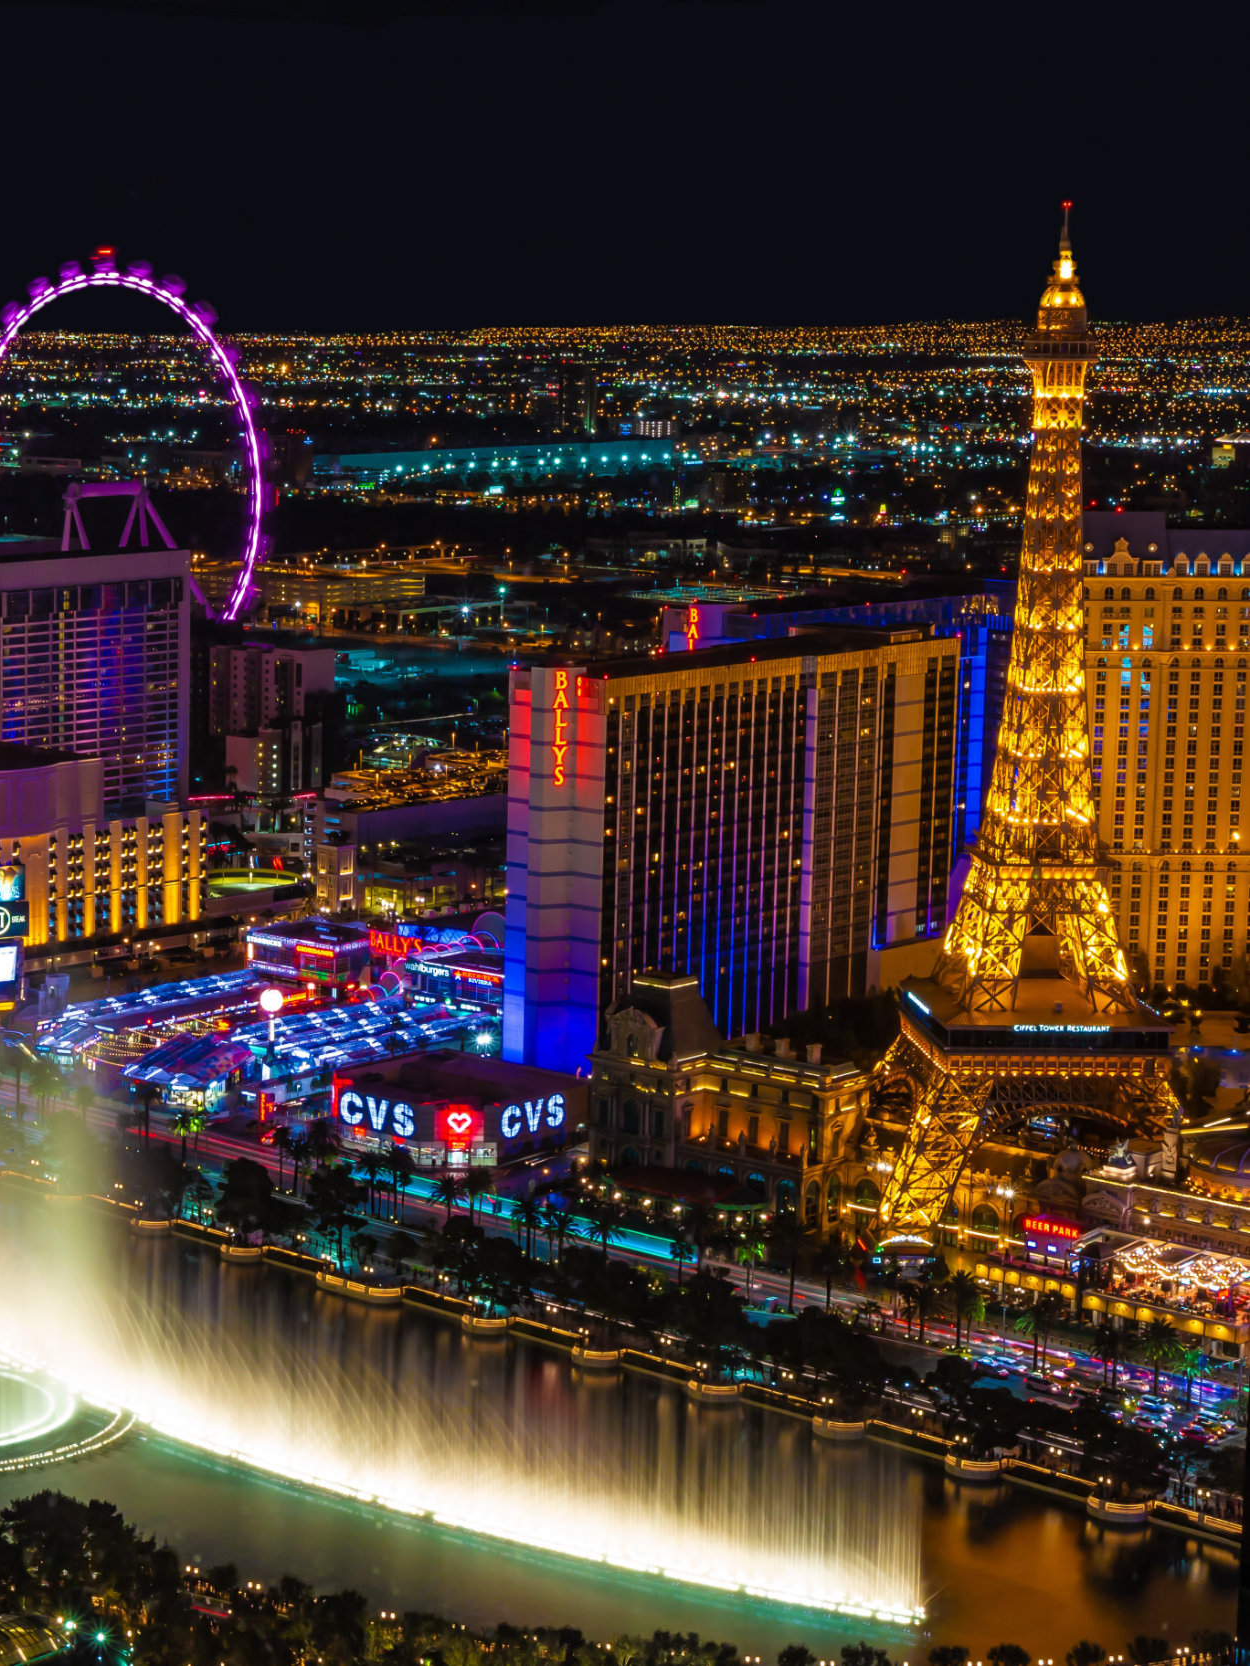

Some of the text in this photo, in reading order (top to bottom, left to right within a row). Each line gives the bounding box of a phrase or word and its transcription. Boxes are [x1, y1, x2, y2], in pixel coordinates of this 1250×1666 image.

[552, 671, 569, 785] BALLYS
[370, 929, 422, 953] BALLY'S
[405, 963, 449, 977] wahlburgers
[1013, 1024, 1110, 1032] EIFFEL TOWER RESTAURANT
[340, 1091, 415, 1137] CVS
[501, 1094, 564, 1138] CVS
[1025, 1219, 1079, 1239] BEER PARK
